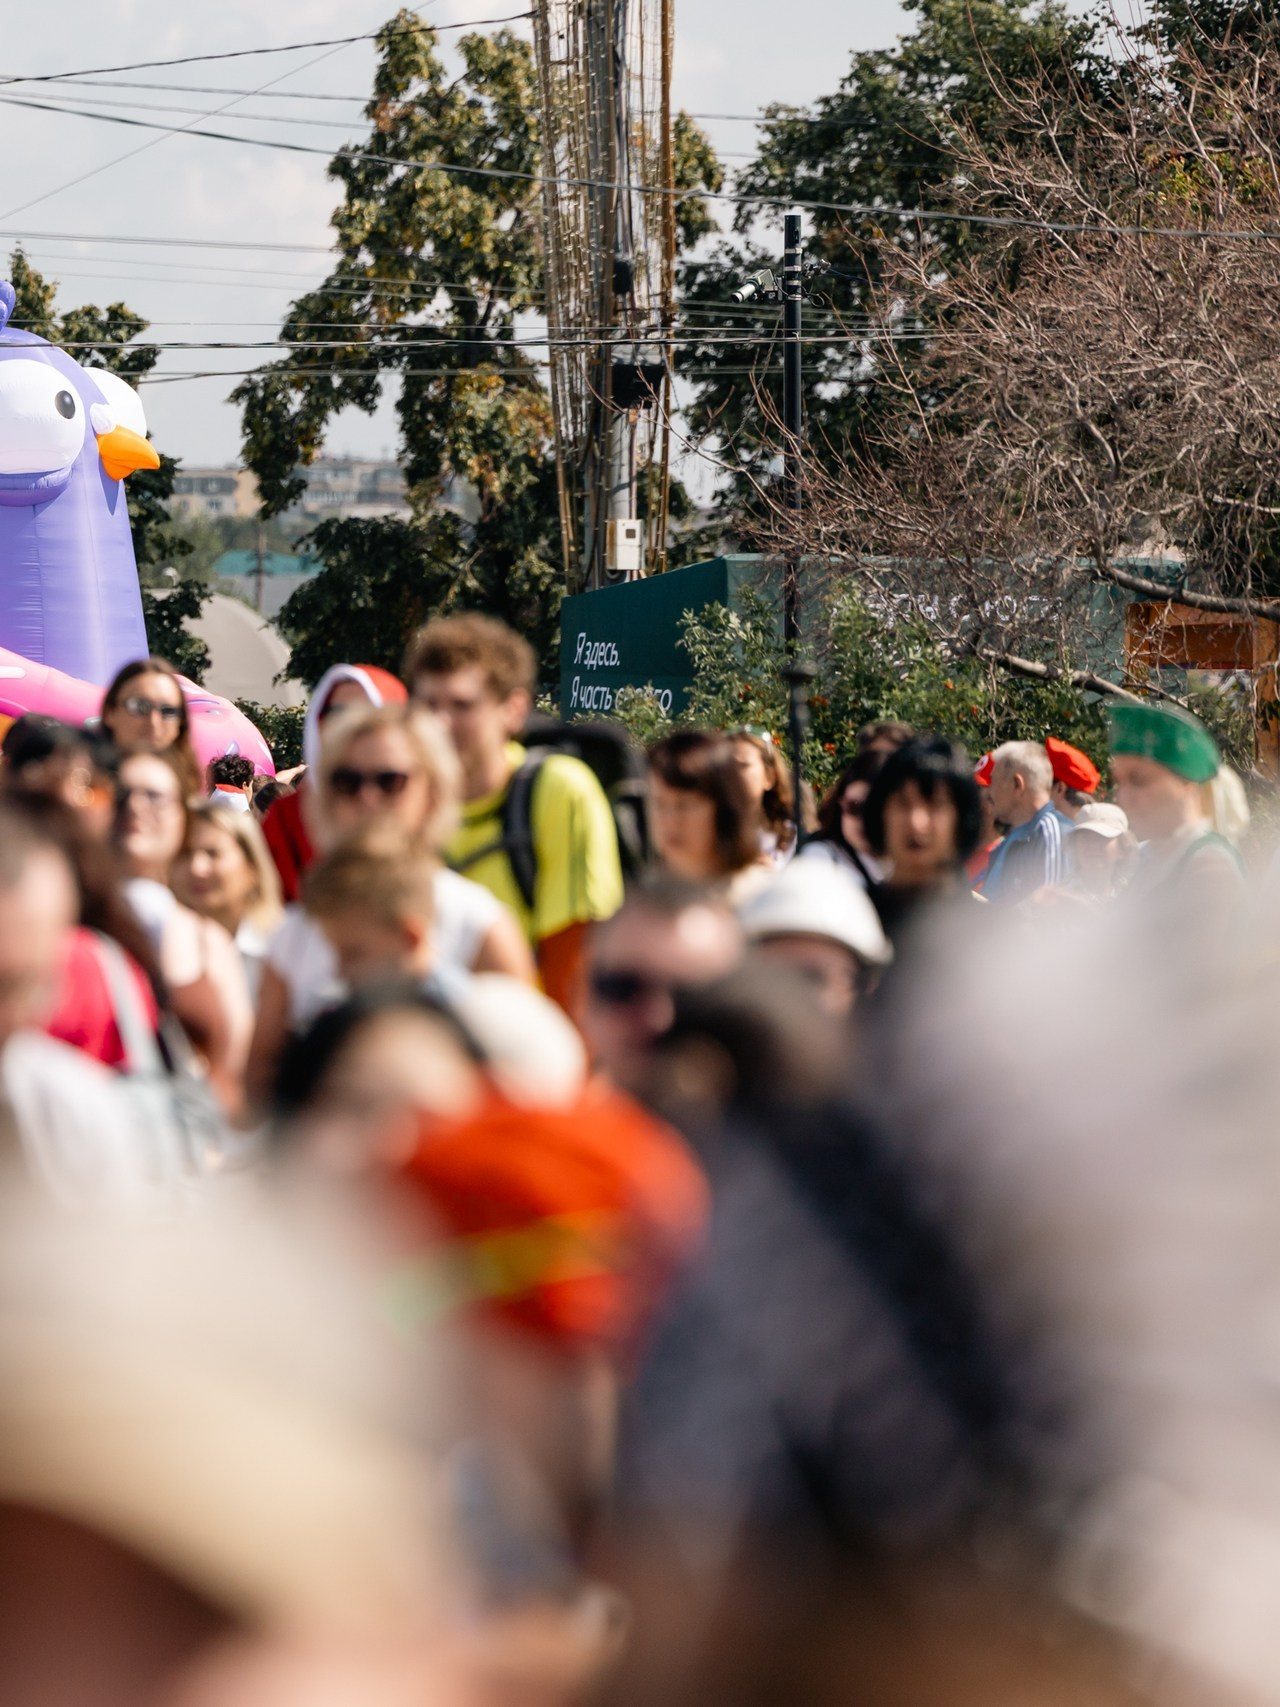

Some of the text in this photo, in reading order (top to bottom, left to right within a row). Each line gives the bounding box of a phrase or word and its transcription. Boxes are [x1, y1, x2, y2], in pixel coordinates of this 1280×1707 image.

[574, 632, 620, 670] Я здесь.
[570, 676, 580, 708] Я
[580, 685, 612, 710] часть
